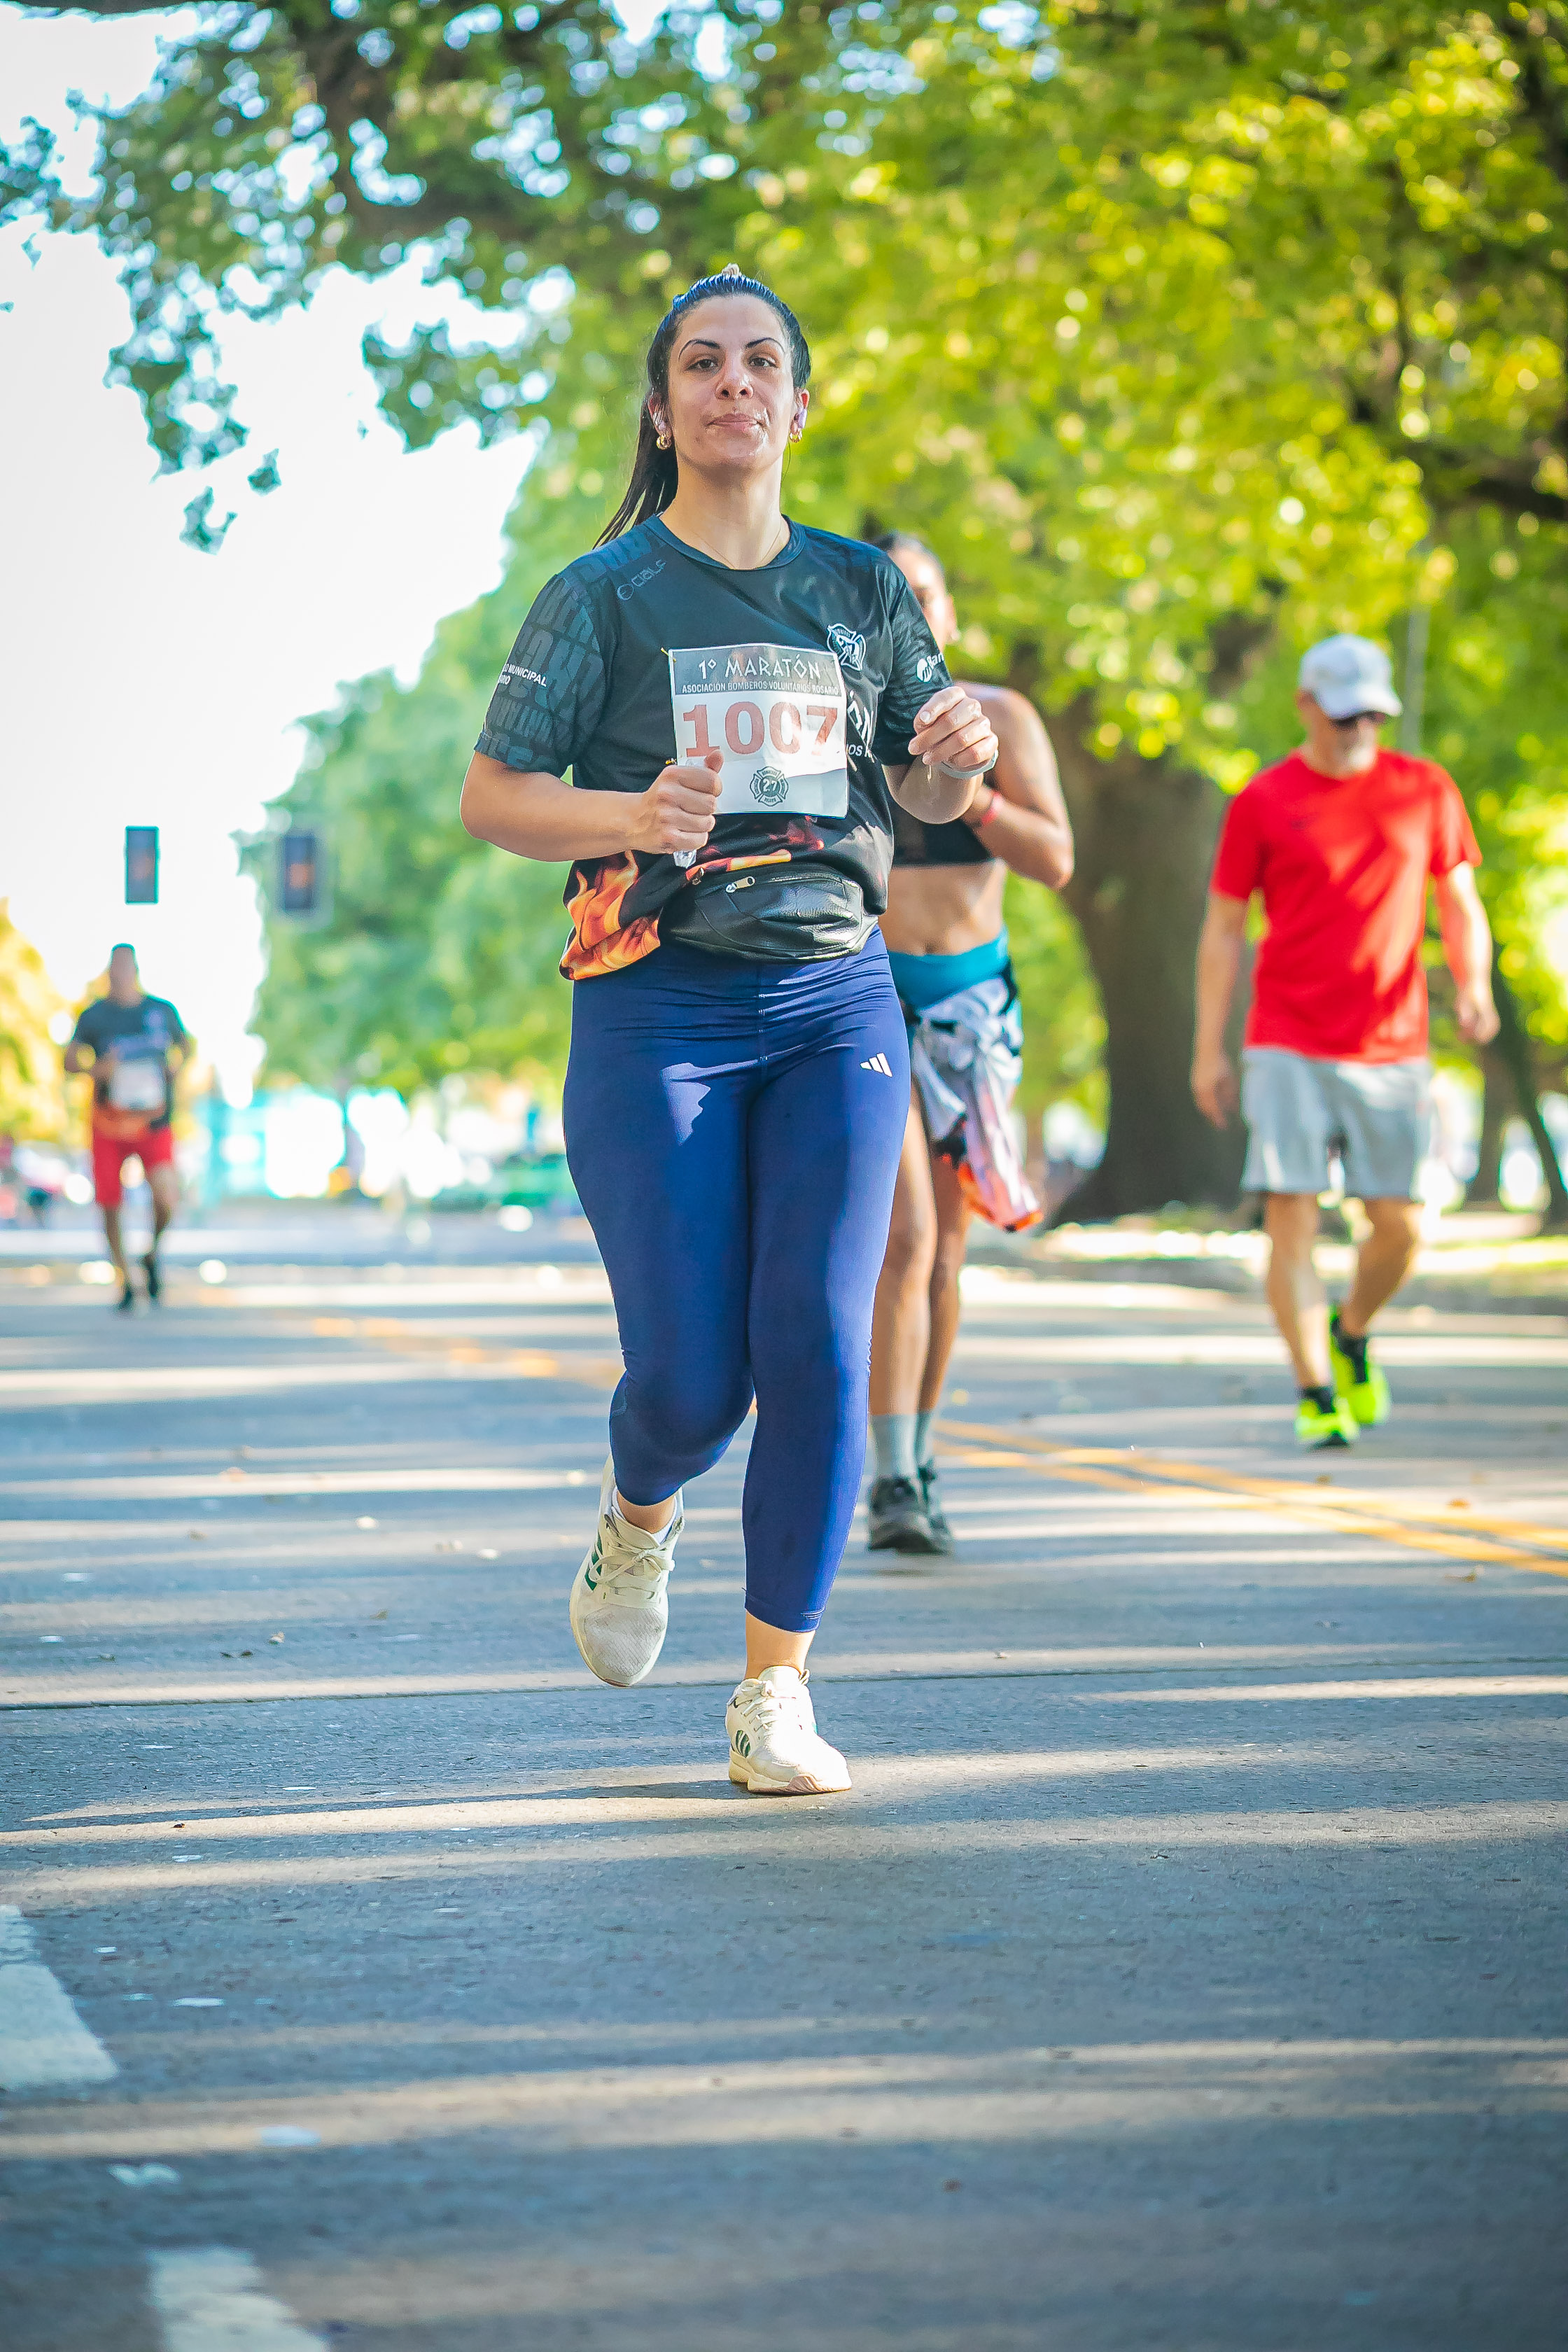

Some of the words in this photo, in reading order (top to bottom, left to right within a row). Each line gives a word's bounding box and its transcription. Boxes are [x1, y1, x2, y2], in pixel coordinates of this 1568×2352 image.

[507, 664, 547, 687] MUNICIPAL
[724, 653, 821, 680] MARATÓN
[682, 681, 727, 694] ASOCIACIÓN
[727, 680, 768, 691] BOMBEROS
[769, 681, 811, 693] VOLUNTARIOS
[811, 684, 839, 696] ROSARIO
[683, 701, 838, 757] 1007
[762, 778, 778, 792] 27
